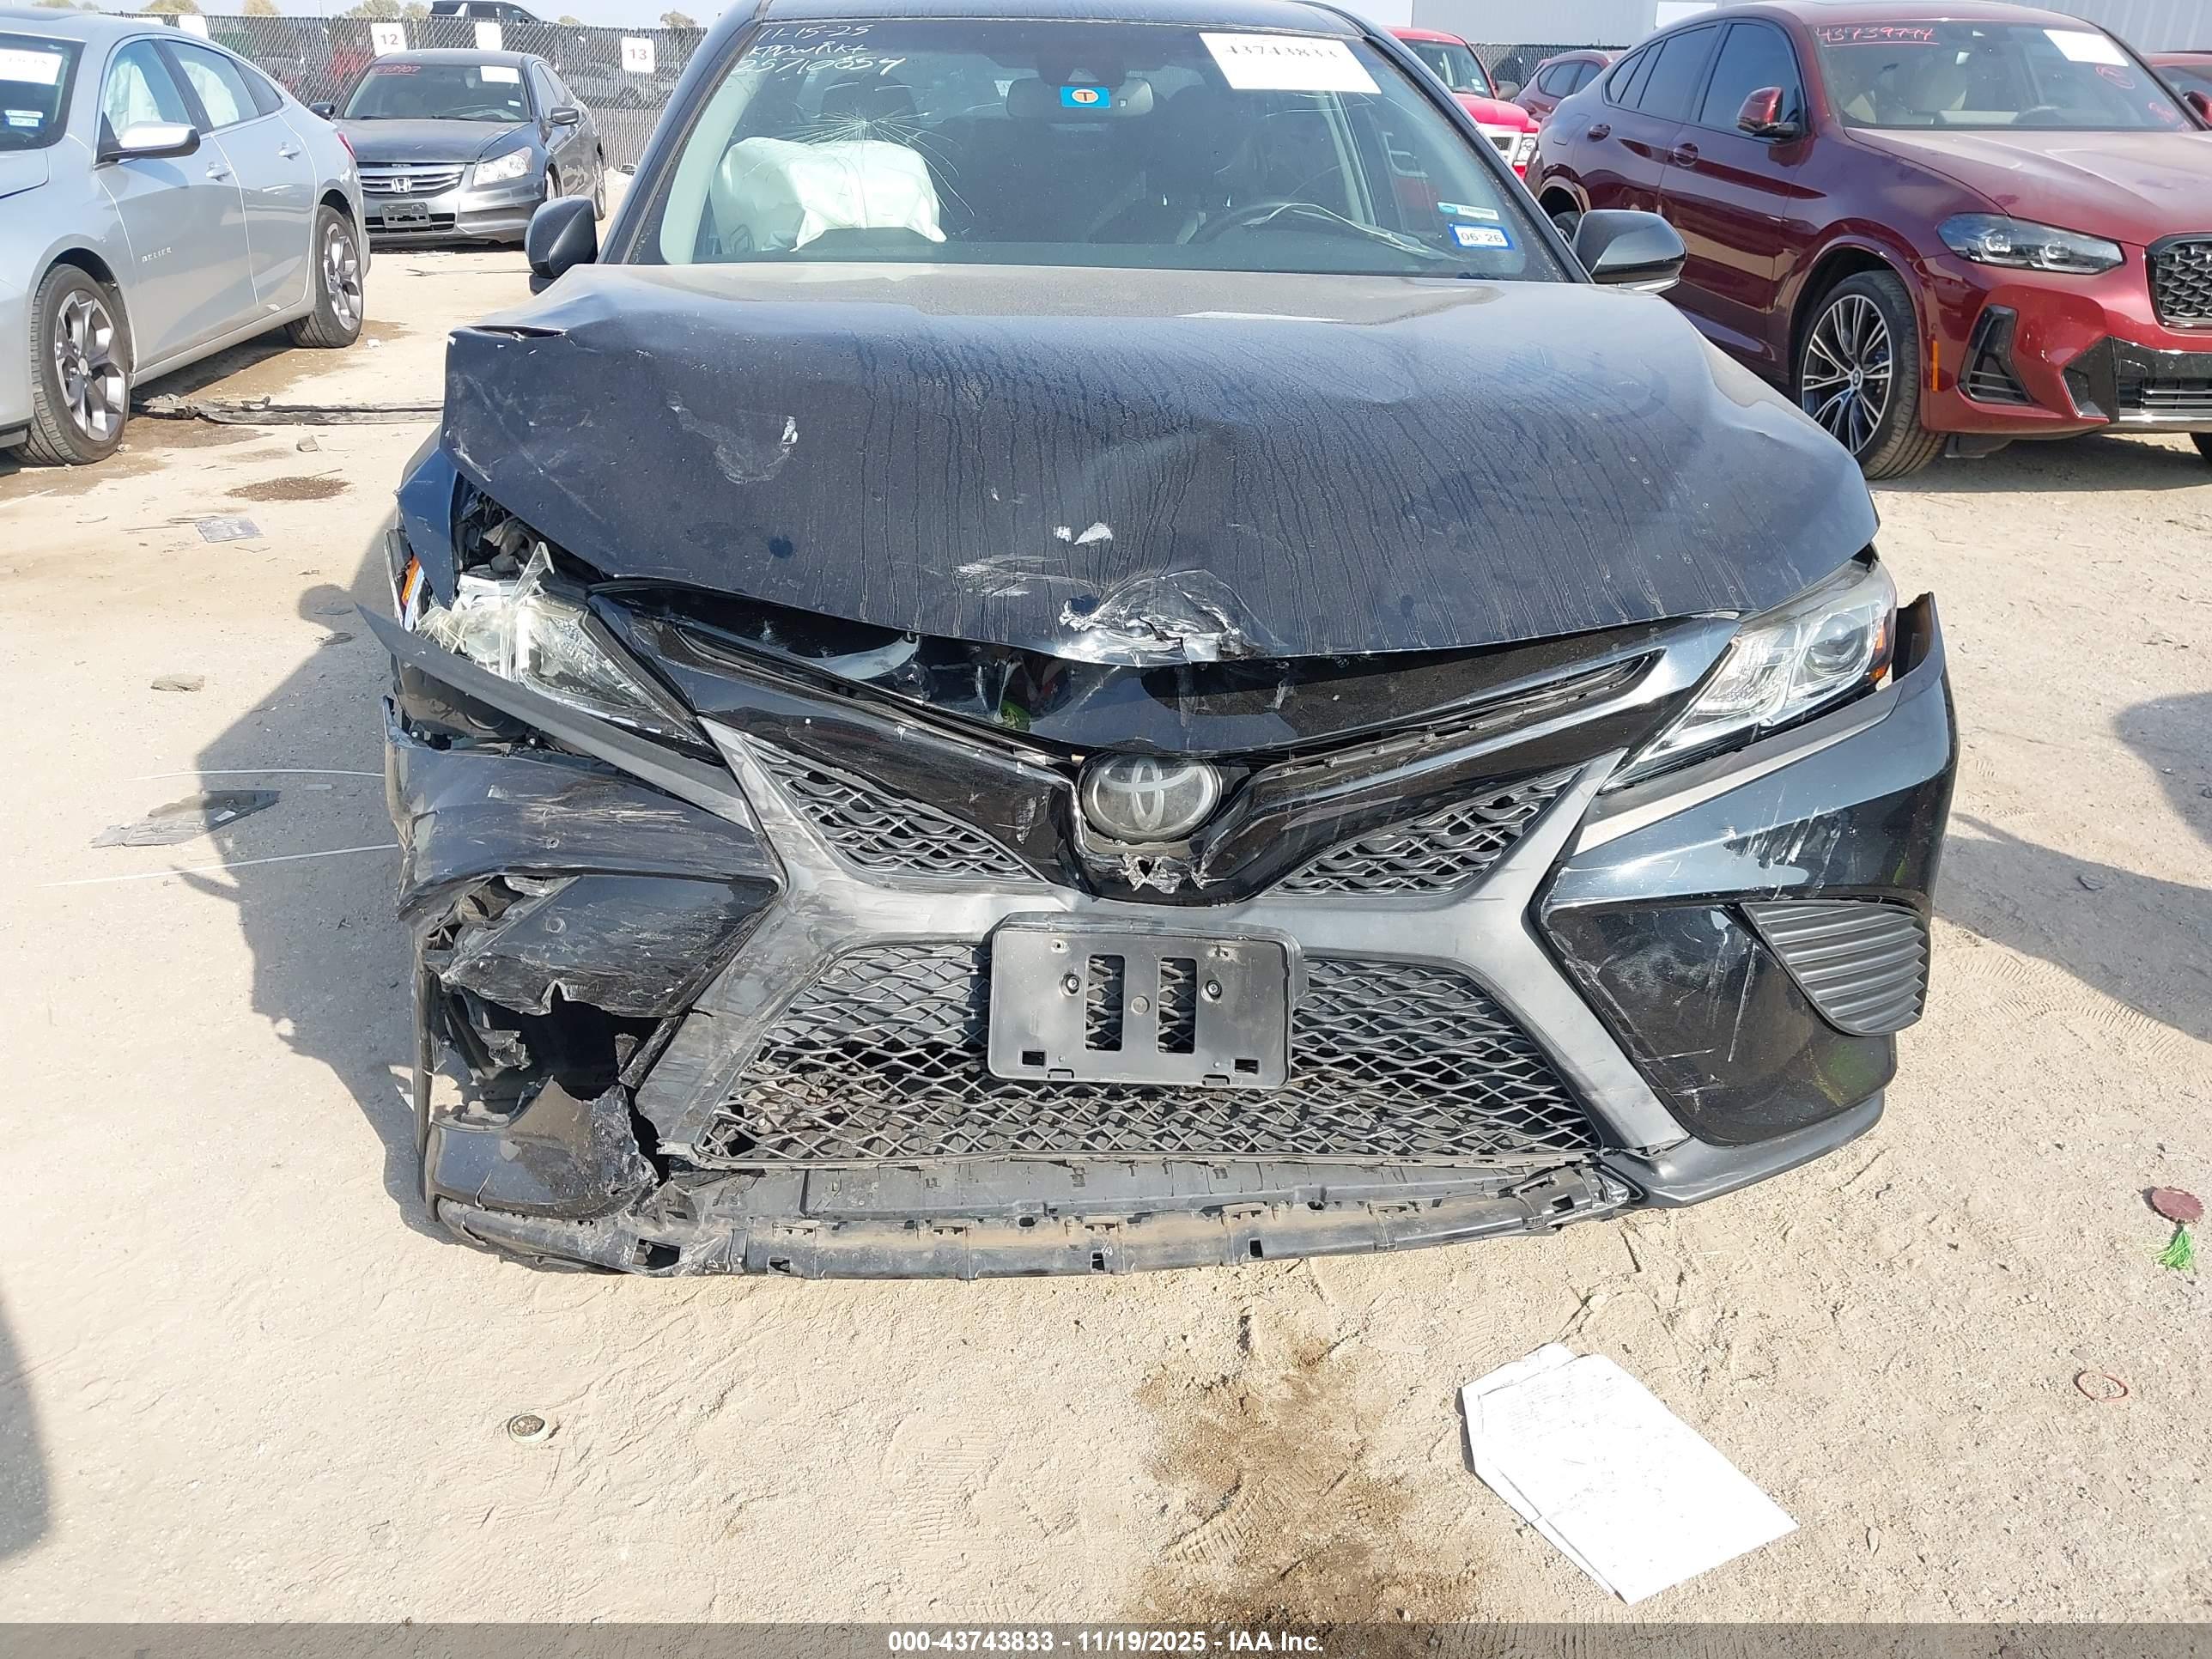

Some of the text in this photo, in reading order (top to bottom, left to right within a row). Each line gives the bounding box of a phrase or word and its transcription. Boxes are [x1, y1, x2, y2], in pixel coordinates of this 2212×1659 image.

[757, 24, 875, 42] 11-15-25
[380, 33, 398, 46] 12
[629, 49, 648, 61] 13
[1077, 91, 1093, 101] T
[1461, 232, 1503, 243] 06 26
